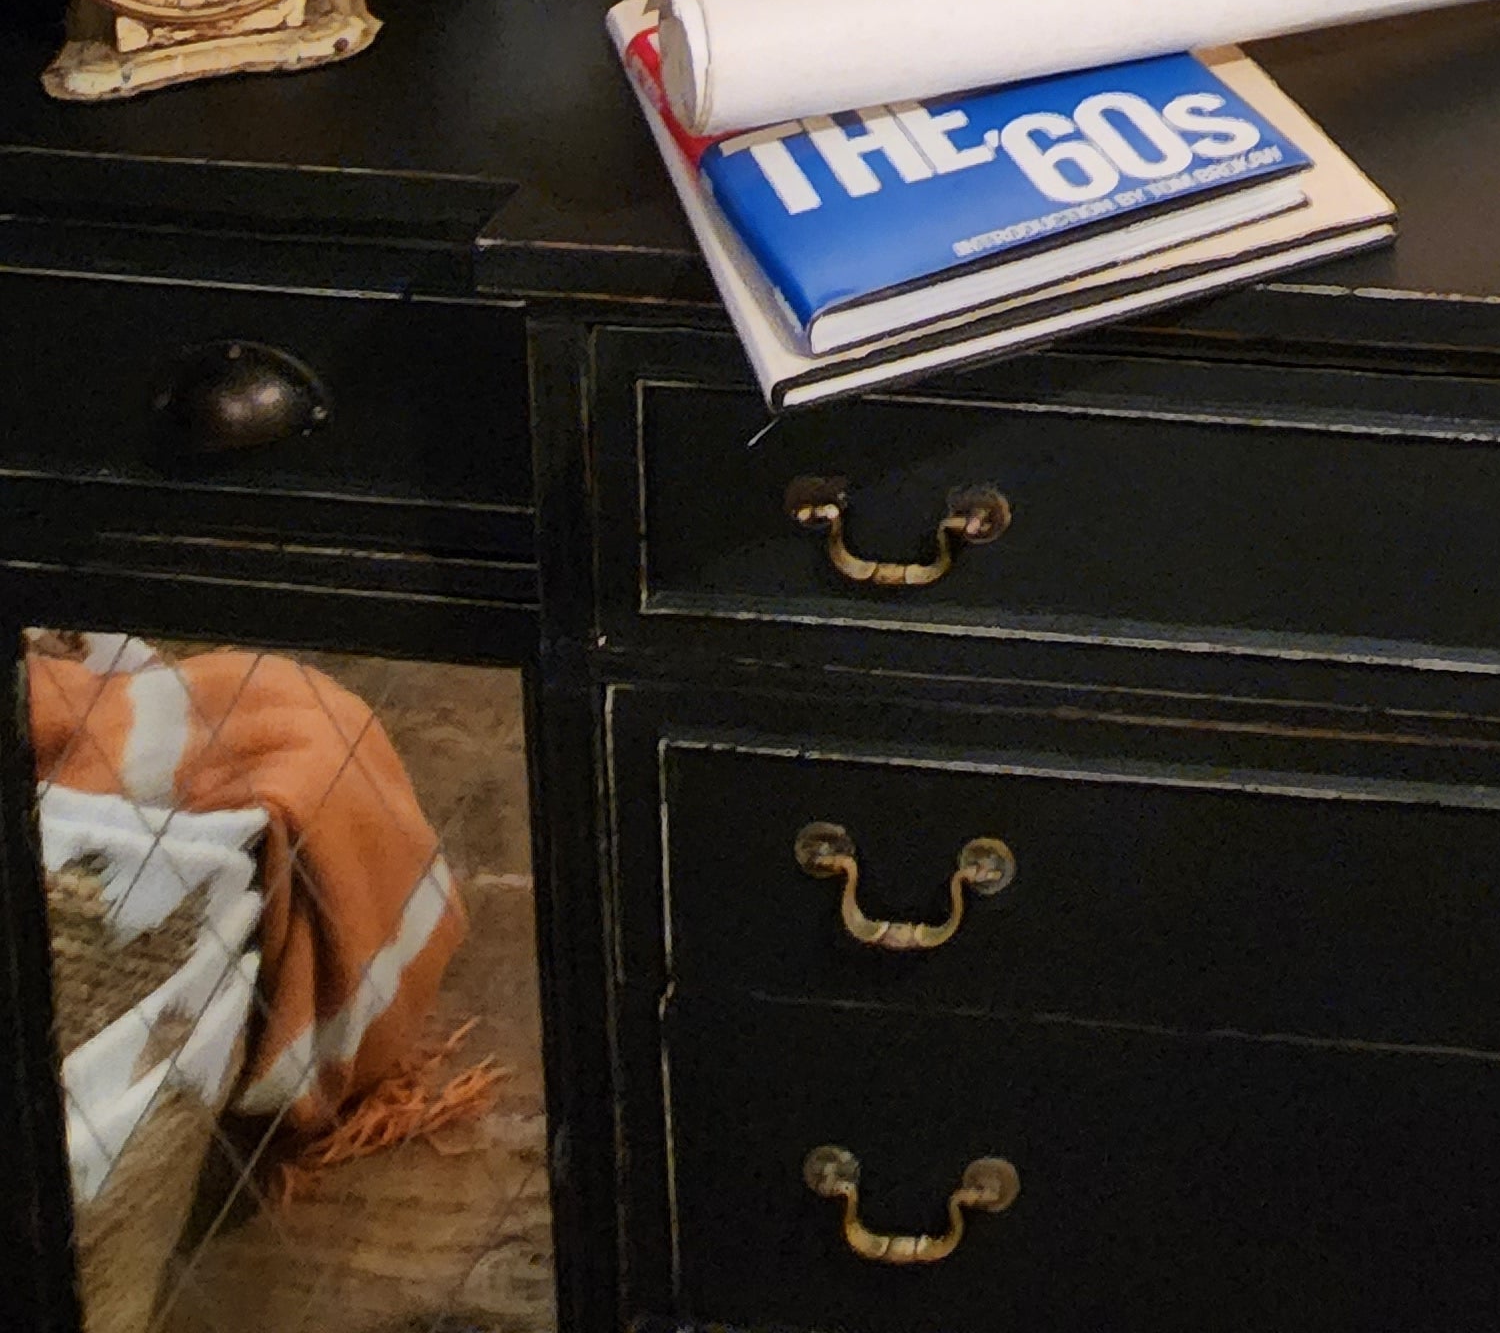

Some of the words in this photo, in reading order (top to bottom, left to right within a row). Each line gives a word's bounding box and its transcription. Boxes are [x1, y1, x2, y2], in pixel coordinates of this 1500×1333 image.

[719, 100, 997, 215] THE
[952, 199, 1116, 257] INTRODUCTION
[1114, 189, 1144, 207] BY
[1149, 173, 1192, 198] TOM
[1191, 145, 1283, 184] BROKAW
